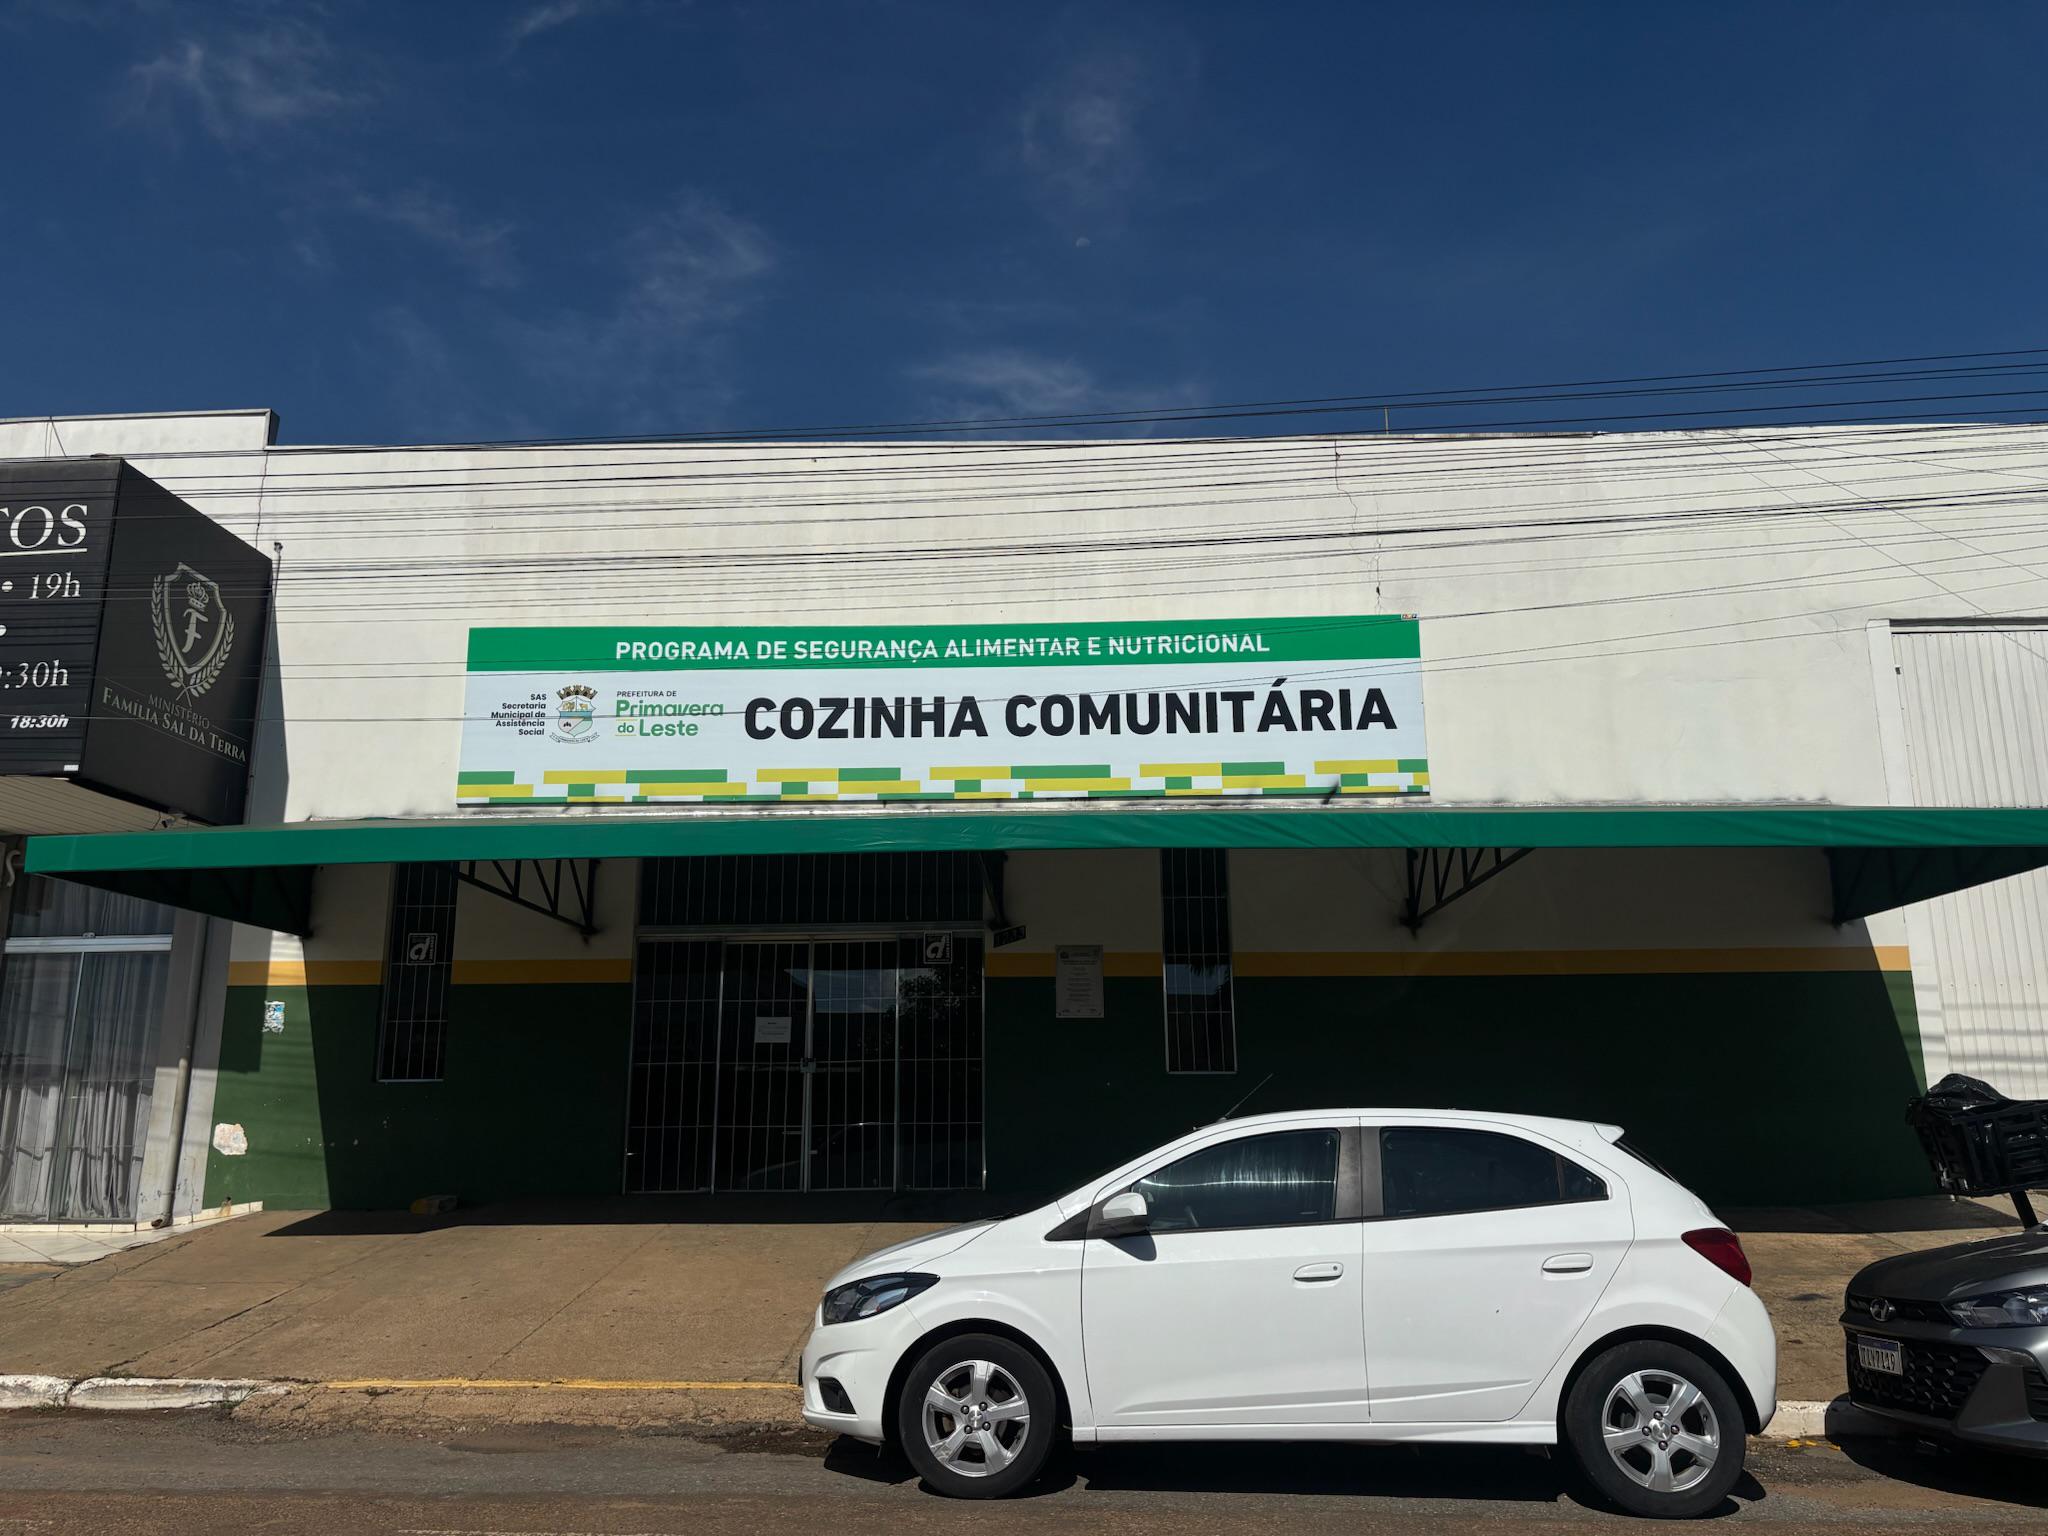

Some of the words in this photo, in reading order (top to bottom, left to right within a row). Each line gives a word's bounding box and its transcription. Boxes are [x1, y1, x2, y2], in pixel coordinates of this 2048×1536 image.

[29, 571, 81, 599] 19h
[616, 641, 750, 660] PROGRAMA
[756, 641, 787, 660] DE
[793, 639, 938, 663] SEGURANÇA
[944, 637, 1080, 658] ALIMENTAR
[1088, 637, 1101, 656] E
[1109, 633, 1270, 656] NUTRICIONAL
[0, 659, 70, 689] :30h
[530, 693, 547, 701] SAS
[616, 690, 665, 698] PREFEITURA
[148, 694, 210, 730] MINISTÉRIO
[502, 702, 546, 710] Secretaria
[616, 700, 724, 718] Primavera
[743, 696, 989, 741] COZINHA
[1005, 677, 1399, 738] COMUNITÁRIA
[11, 714, 70, 729] 18:30h
[491, 711, 537, 720] Municipal
[496, 718, 545, 727] Assistência
[518, 728, 545, 736] Social
[617, 722, 634, 734] do
[639, 719, 699, 737] Leste
[162, 713, 186, 736] SAL
[189, 727, 206, 745] DA
[209, 732, 247, 762] TERRA
